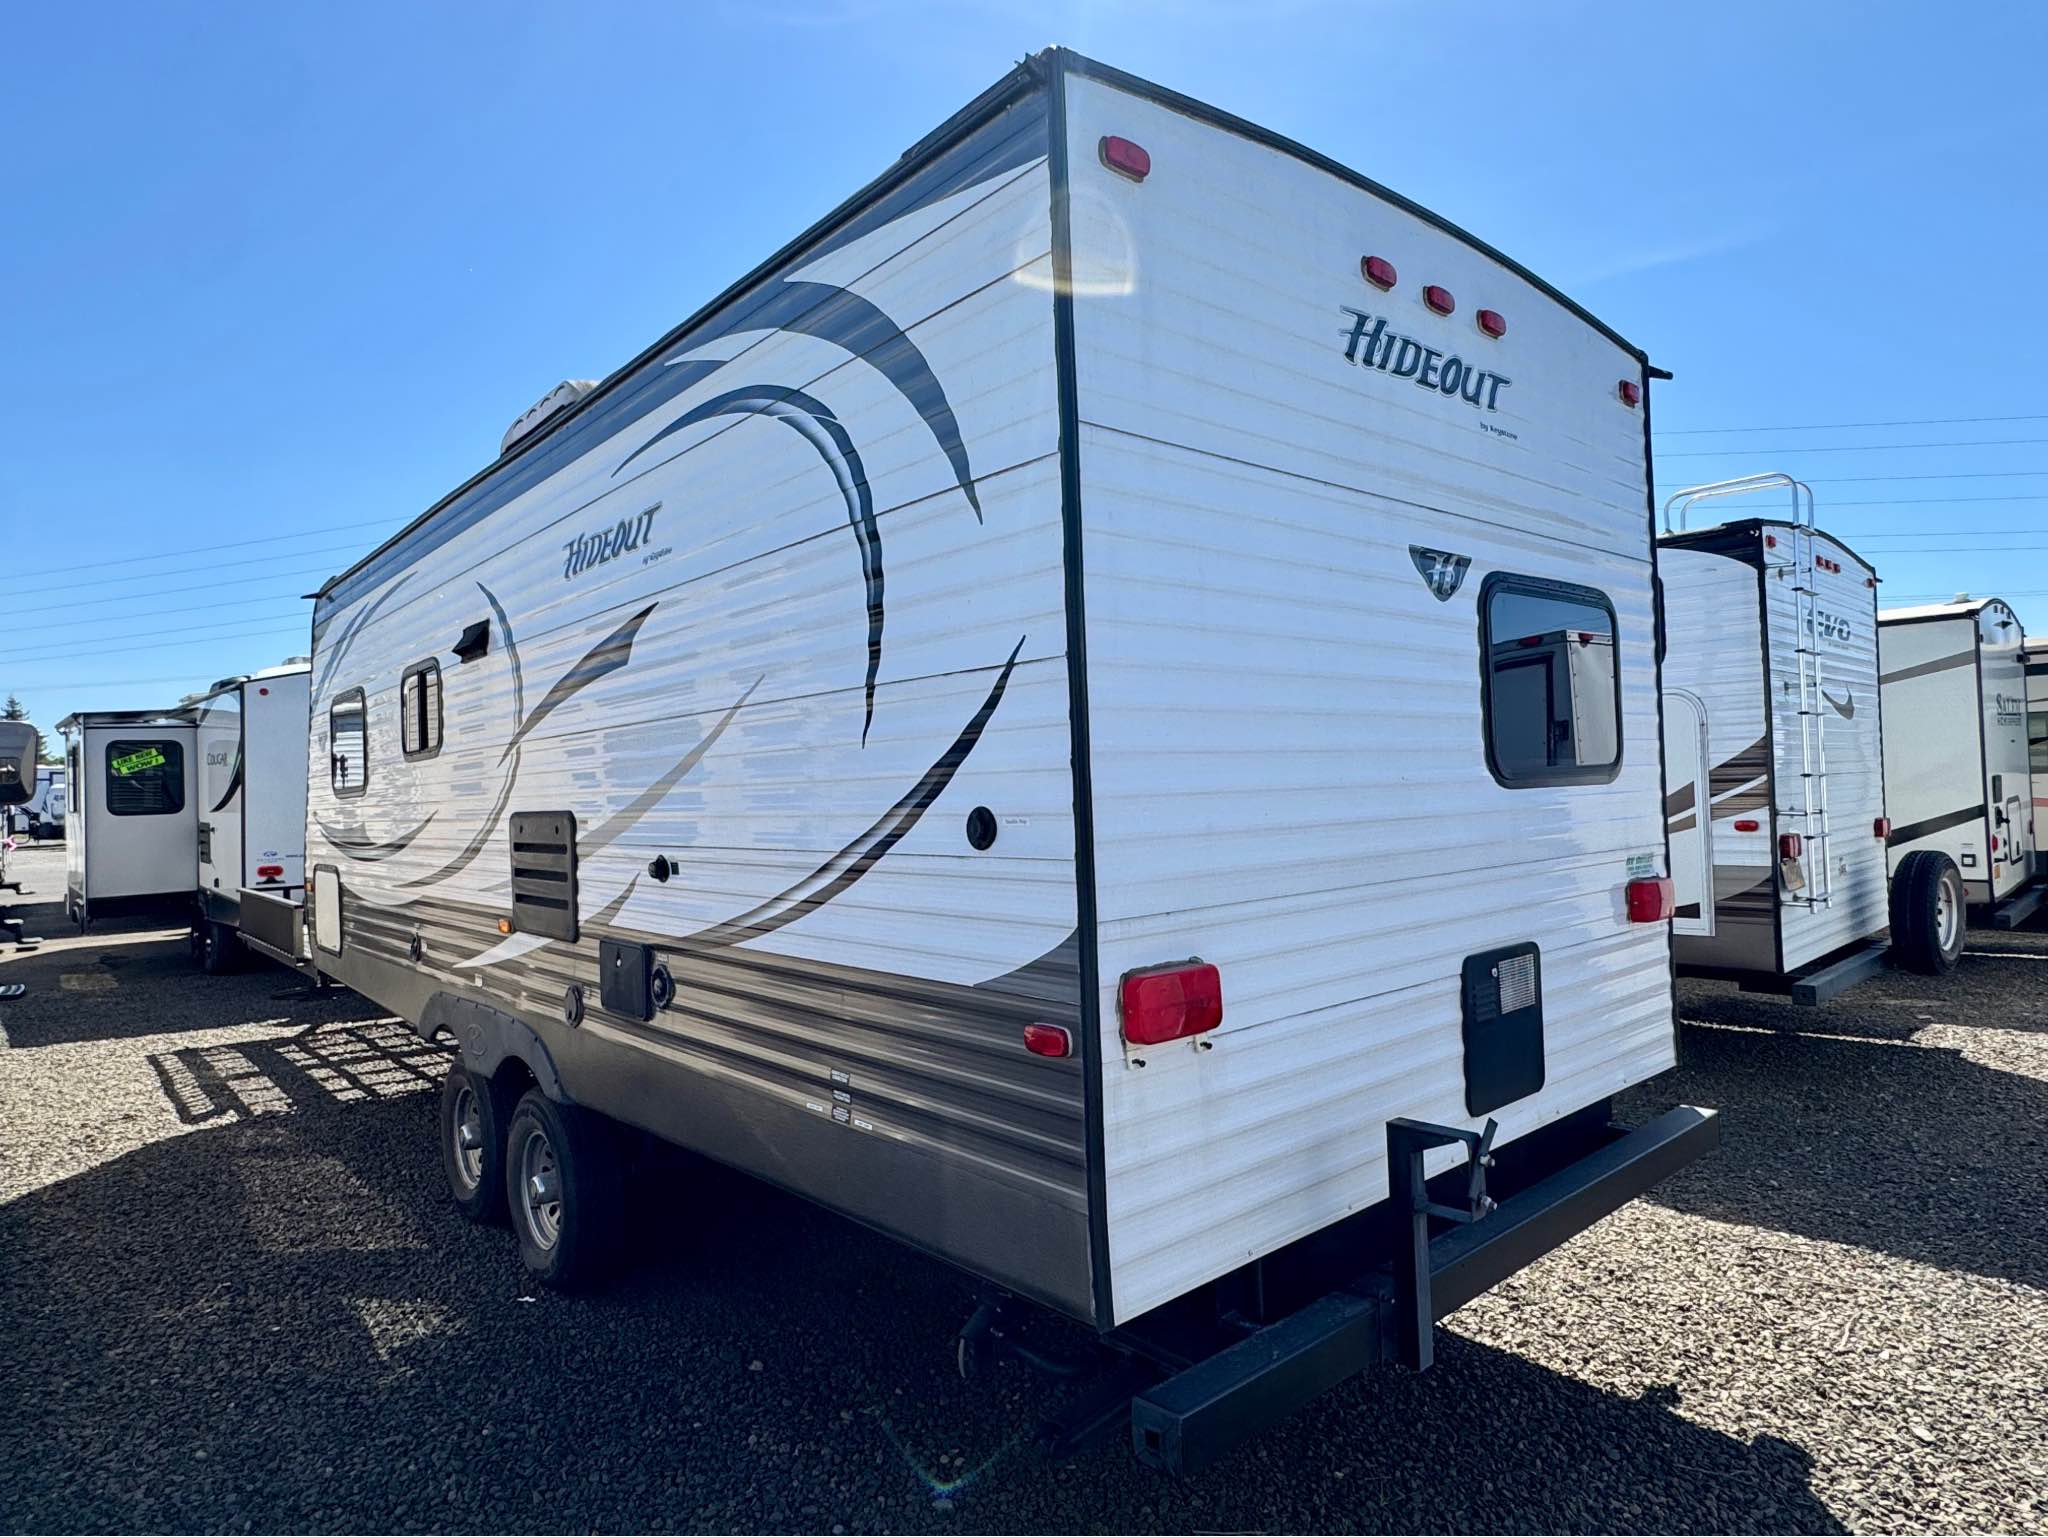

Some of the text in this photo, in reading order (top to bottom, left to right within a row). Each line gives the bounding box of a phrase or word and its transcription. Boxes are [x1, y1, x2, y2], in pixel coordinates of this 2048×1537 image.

[1339, 305, 1512, 413] HIDEOUT
[562, 501, 662, 581] HIDEOUT
[116, 750, 153, 766] LIKE NEW
